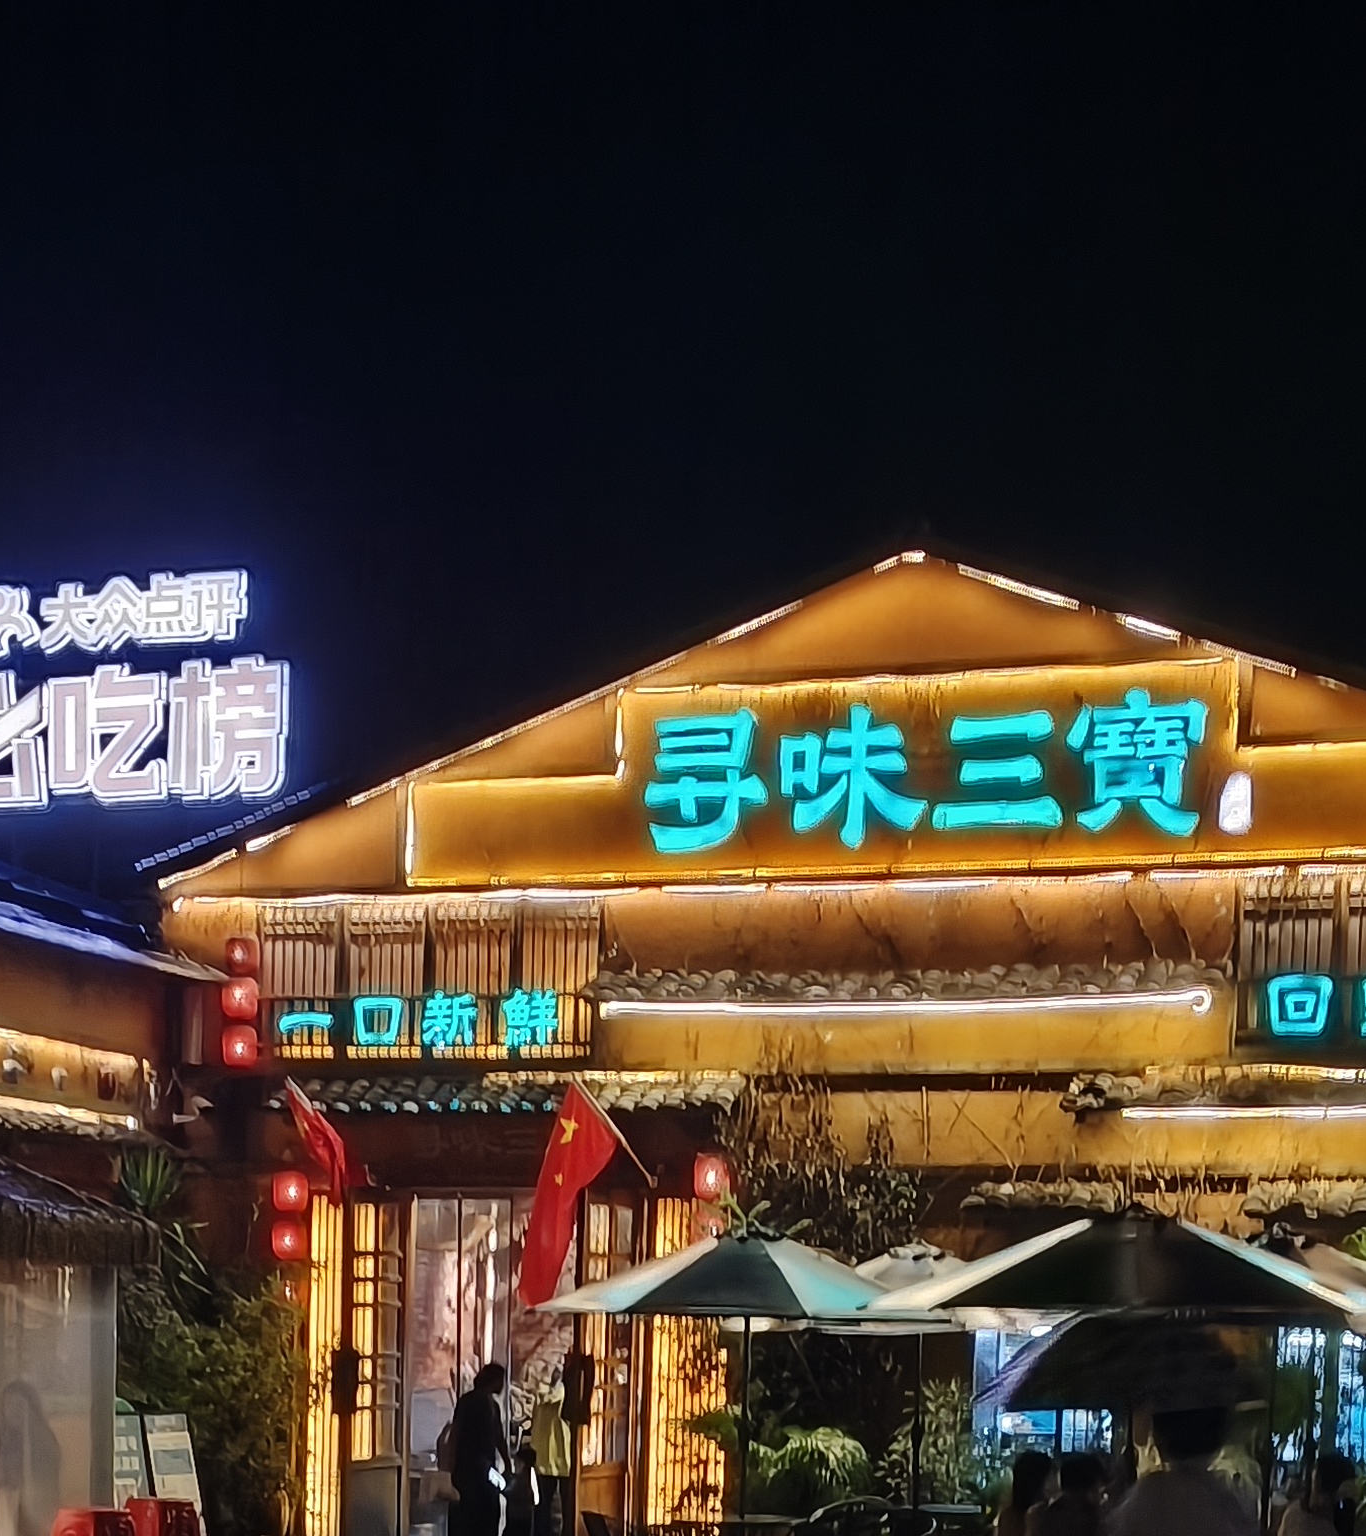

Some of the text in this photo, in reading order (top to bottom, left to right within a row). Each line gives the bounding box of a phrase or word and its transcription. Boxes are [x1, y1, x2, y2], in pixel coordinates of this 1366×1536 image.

[39, 569, 249, 656] 大众点评
[644, 687, 1210, 853] 寻味三寶
[277, 987, 561, 1049] 一口新鮮
